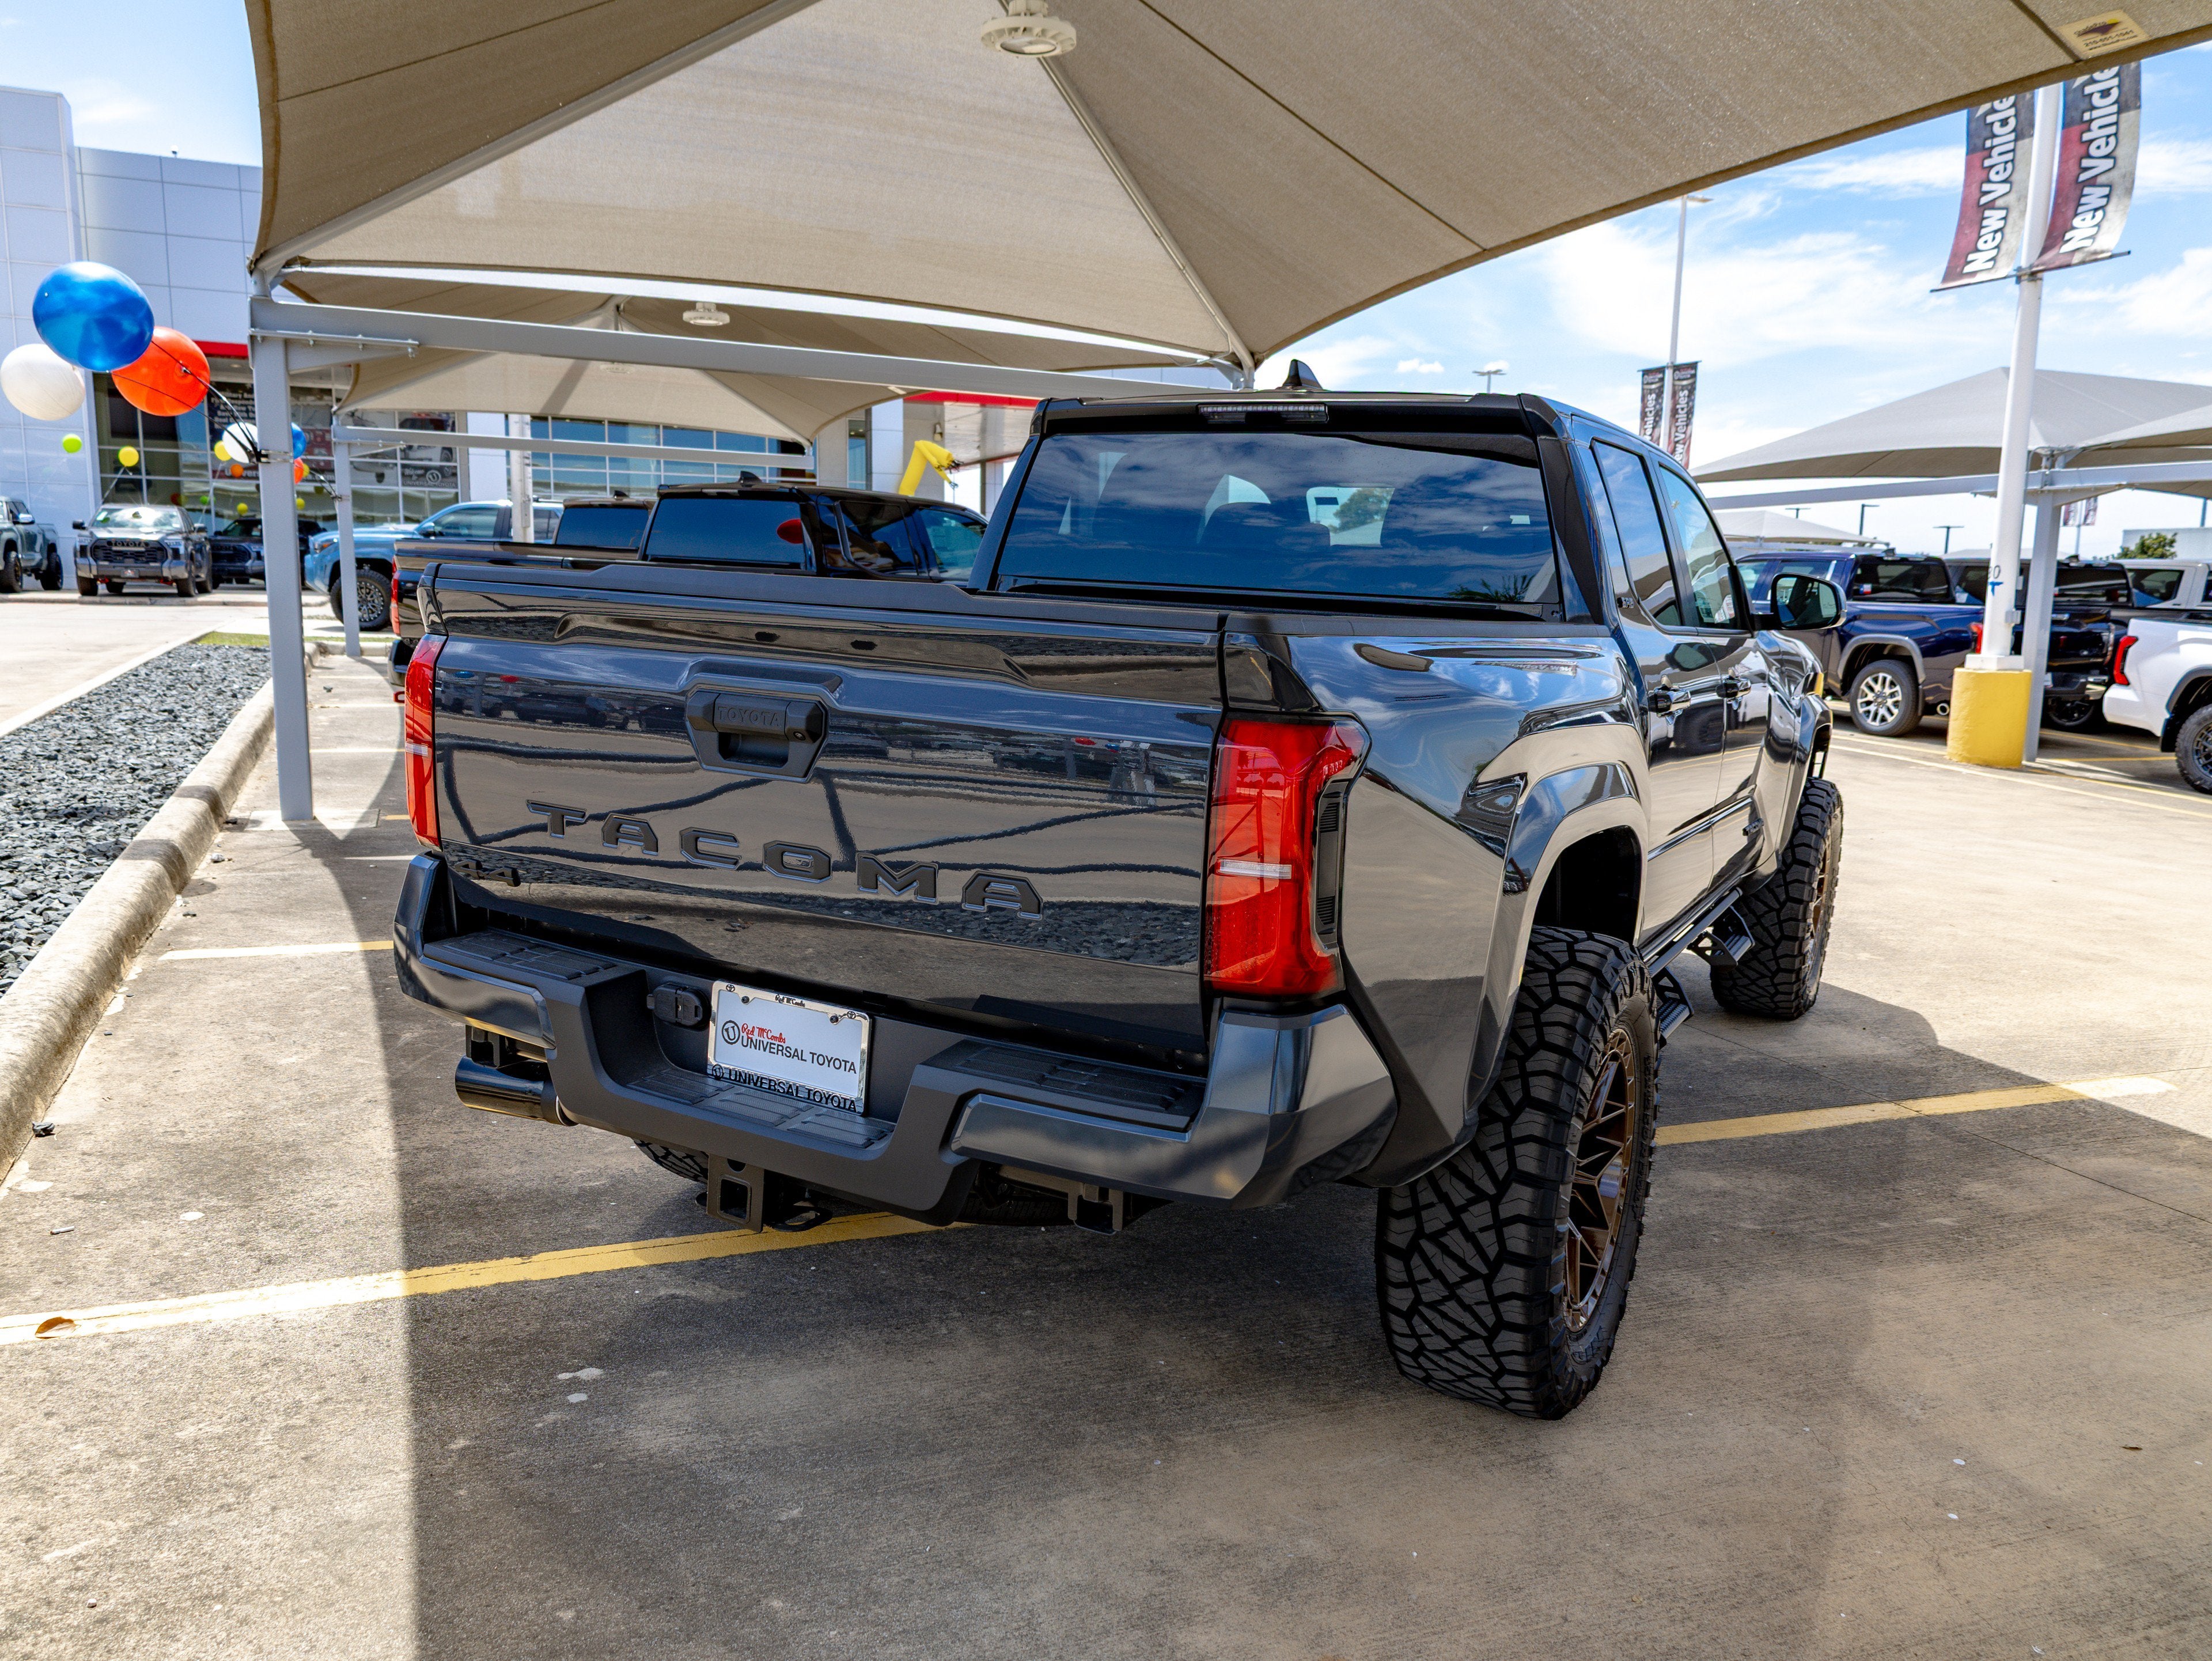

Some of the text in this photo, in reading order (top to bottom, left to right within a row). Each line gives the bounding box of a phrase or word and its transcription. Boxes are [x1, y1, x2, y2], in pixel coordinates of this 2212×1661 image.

[1961, 207, 2009, 274] New
[2059, 185, 2112, 254] New
[1674, 389, 1689, 442] Vehicles
[1674, 443, 1684, 463] ew
[717, 706, 779, 727] TOYOTA
[525, 799, 1045, 921] TACOMA
[775, 994, 805, 1008] Red McCombs
[741, 1023, 756, 1040] Red
[756, 1027, 786, 1044] McCombs
[741, 1035, 857, 1074] UNIVERSAL TOYOTA
[729, 1068, 804, 1099] UNIVERSAL
[805, 1086, 858, 1113] TOYOTA
